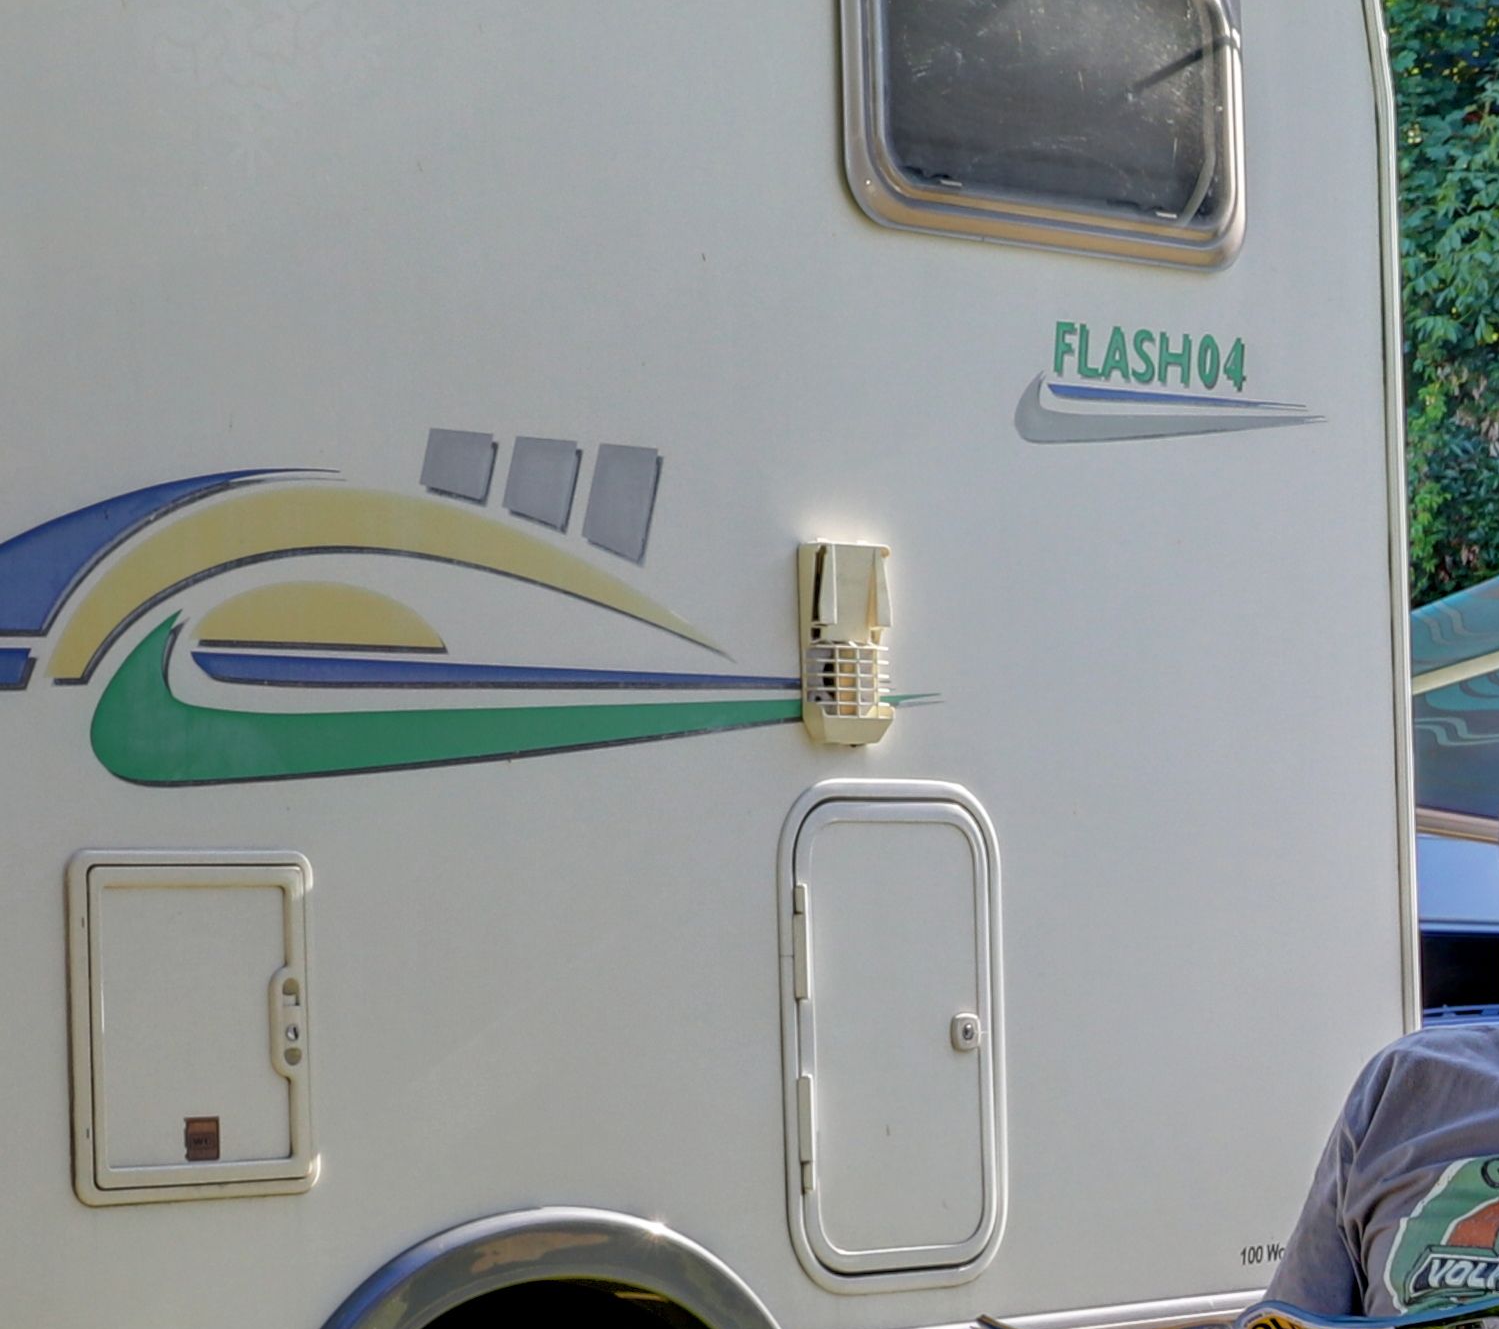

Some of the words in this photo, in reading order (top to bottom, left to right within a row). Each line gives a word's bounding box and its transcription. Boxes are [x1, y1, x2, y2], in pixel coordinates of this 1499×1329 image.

[1053, 321, 1192, 388] FLASH
[1198, 333, 1247, 391] 04
[1240, 1245, 1264, 1266] 100
